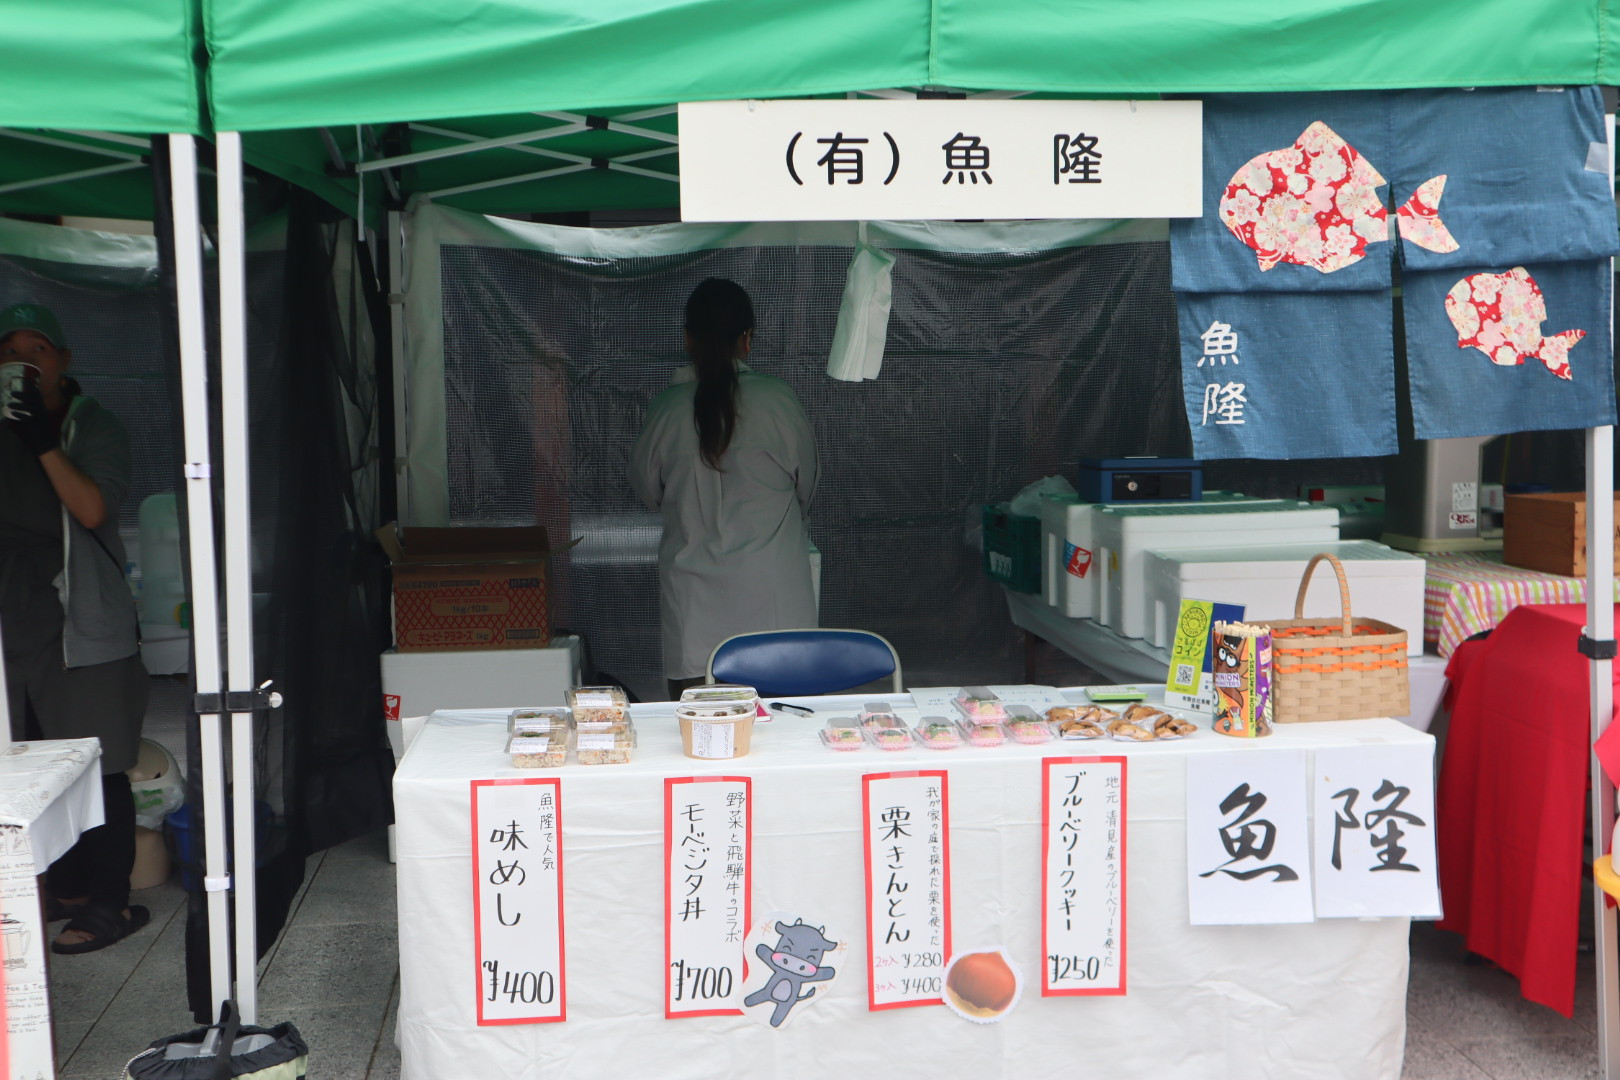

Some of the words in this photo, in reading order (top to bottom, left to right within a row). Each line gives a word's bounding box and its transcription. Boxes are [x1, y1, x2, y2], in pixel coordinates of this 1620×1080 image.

[488, 819, 529, 927] 味めし
[537, 792, 556, 871] 魚隆で人気
[678, 803, 710, 922] モーベジタ丼
[722, 791, 746, 943] 野菜と飛騨牛のコラボ
[877, 805, 912, 945] 栗きんとん
[1058, 771, 1087, 931] ブルーベリークッキー
